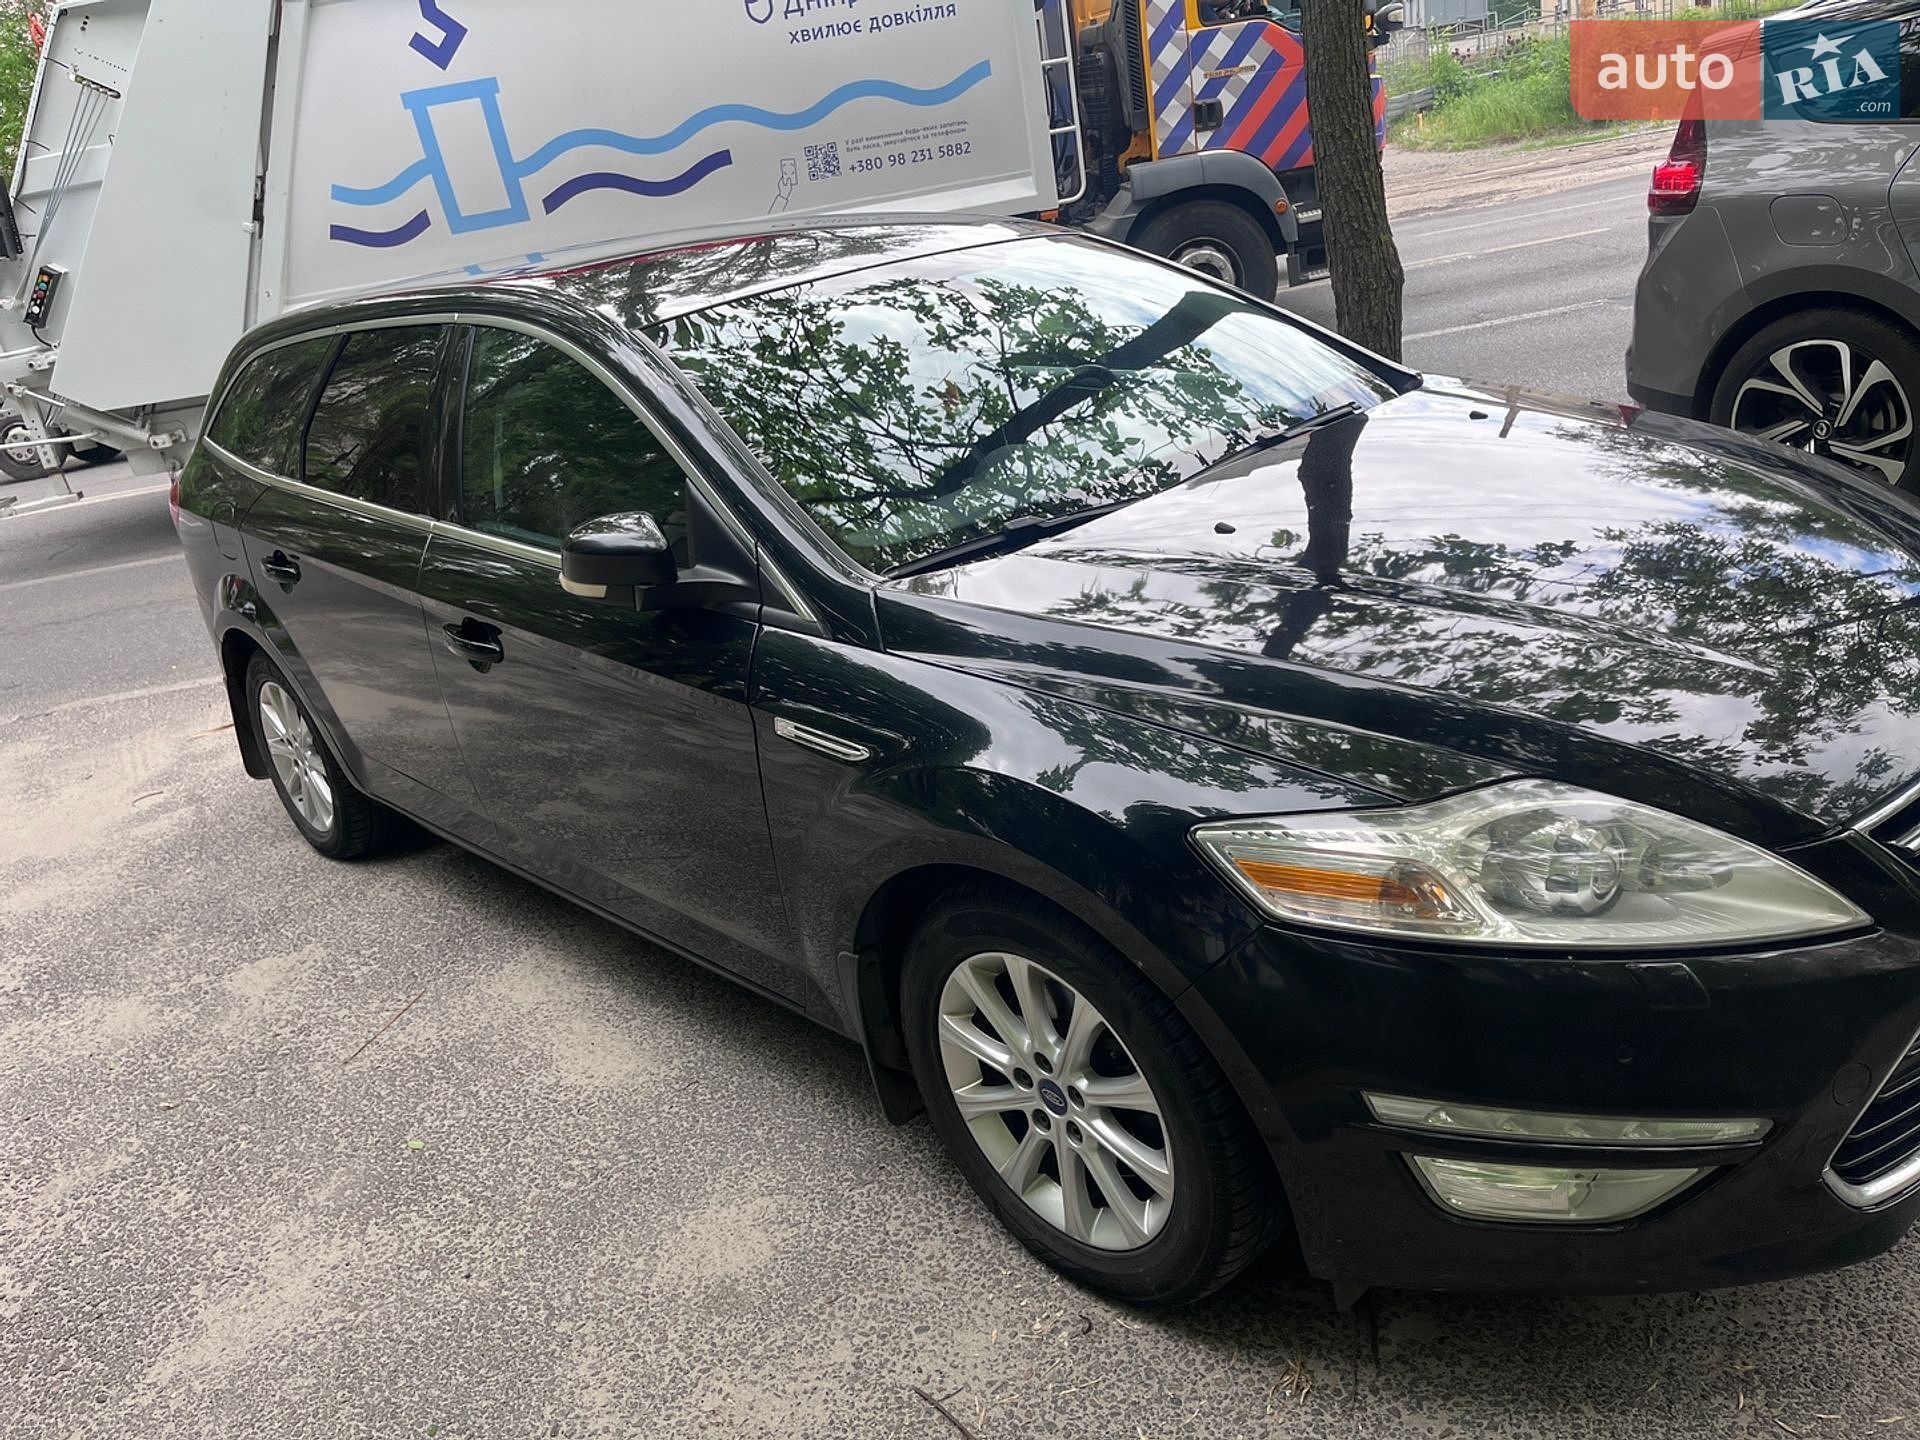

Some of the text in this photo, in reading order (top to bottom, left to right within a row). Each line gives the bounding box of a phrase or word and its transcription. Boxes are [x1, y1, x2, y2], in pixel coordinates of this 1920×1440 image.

[789, 19, 863, 44] хвилює
[869, 3, 957, 34] довкілля
[849, 141, 971, 173] +380 98 231 5882
